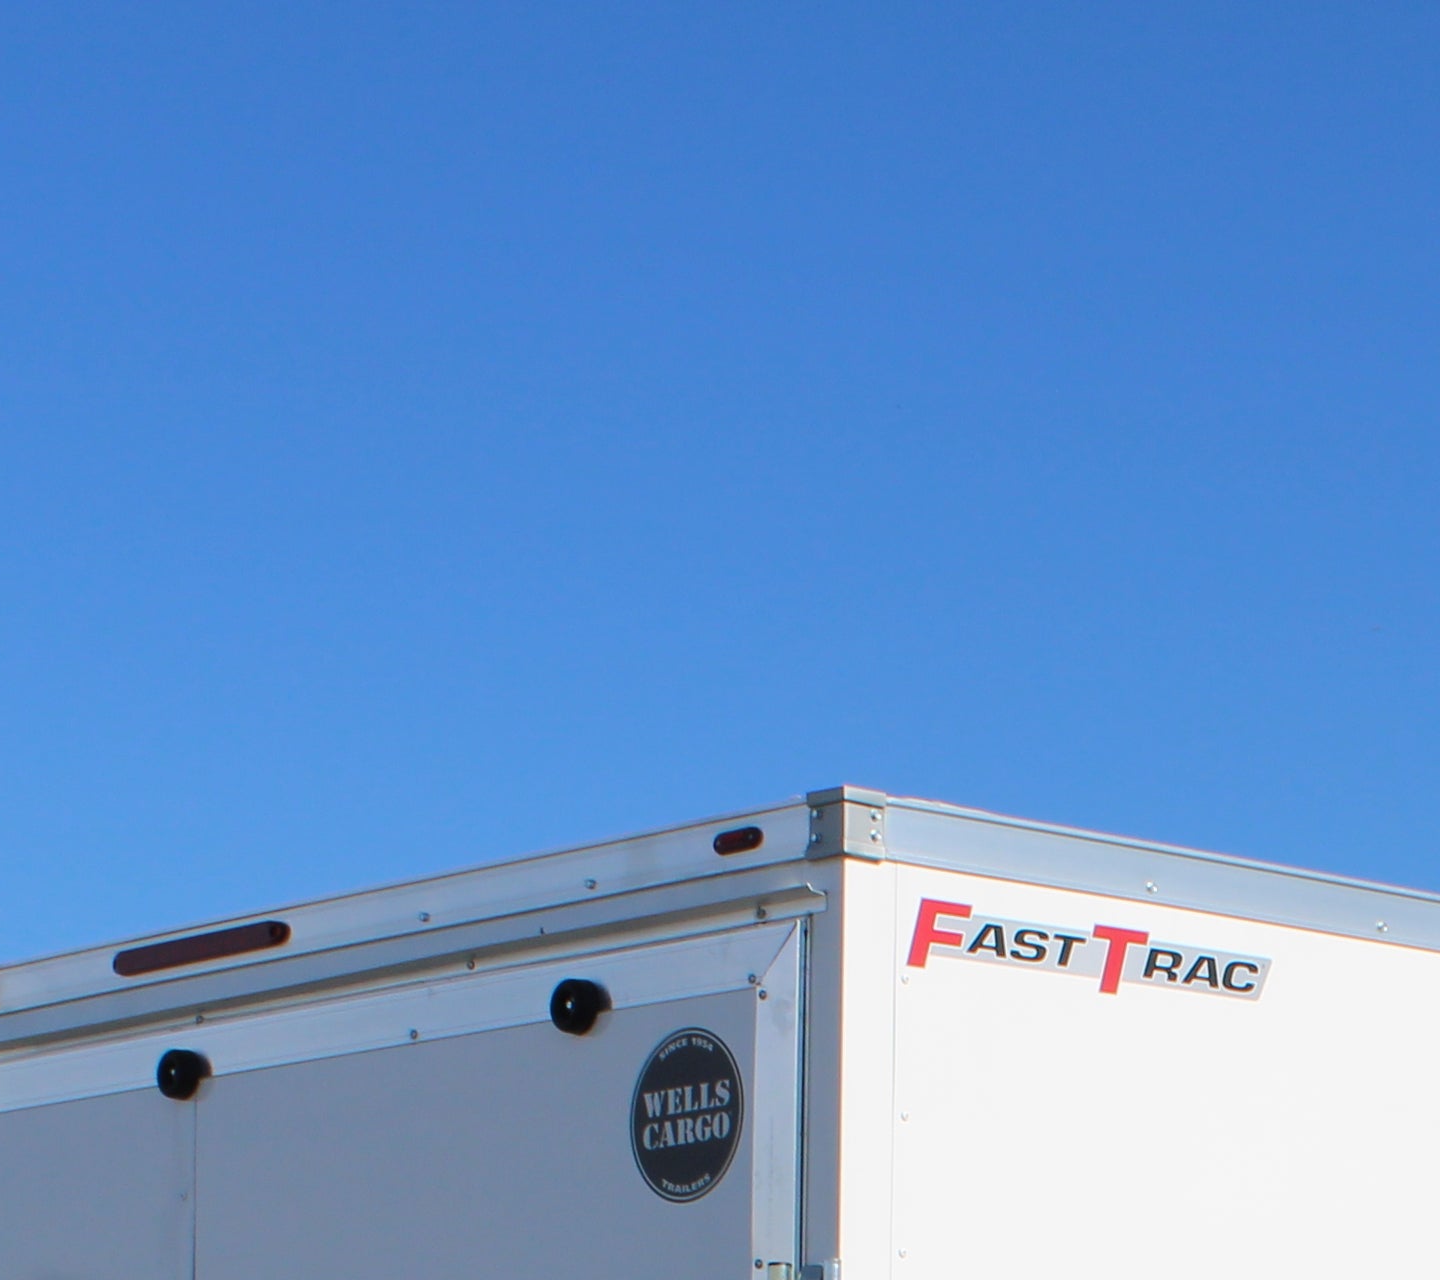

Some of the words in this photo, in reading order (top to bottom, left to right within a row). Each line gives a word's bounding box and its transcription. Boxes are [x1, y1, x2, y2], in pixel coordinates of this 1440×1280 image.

[659, 1037, 688, 1062] SINCE
[643, 1079, 730, 1119] WELLS
[643, 1111, 730, 1151] CARGO
[662, 1173, 710, 1193] TRAILERS
